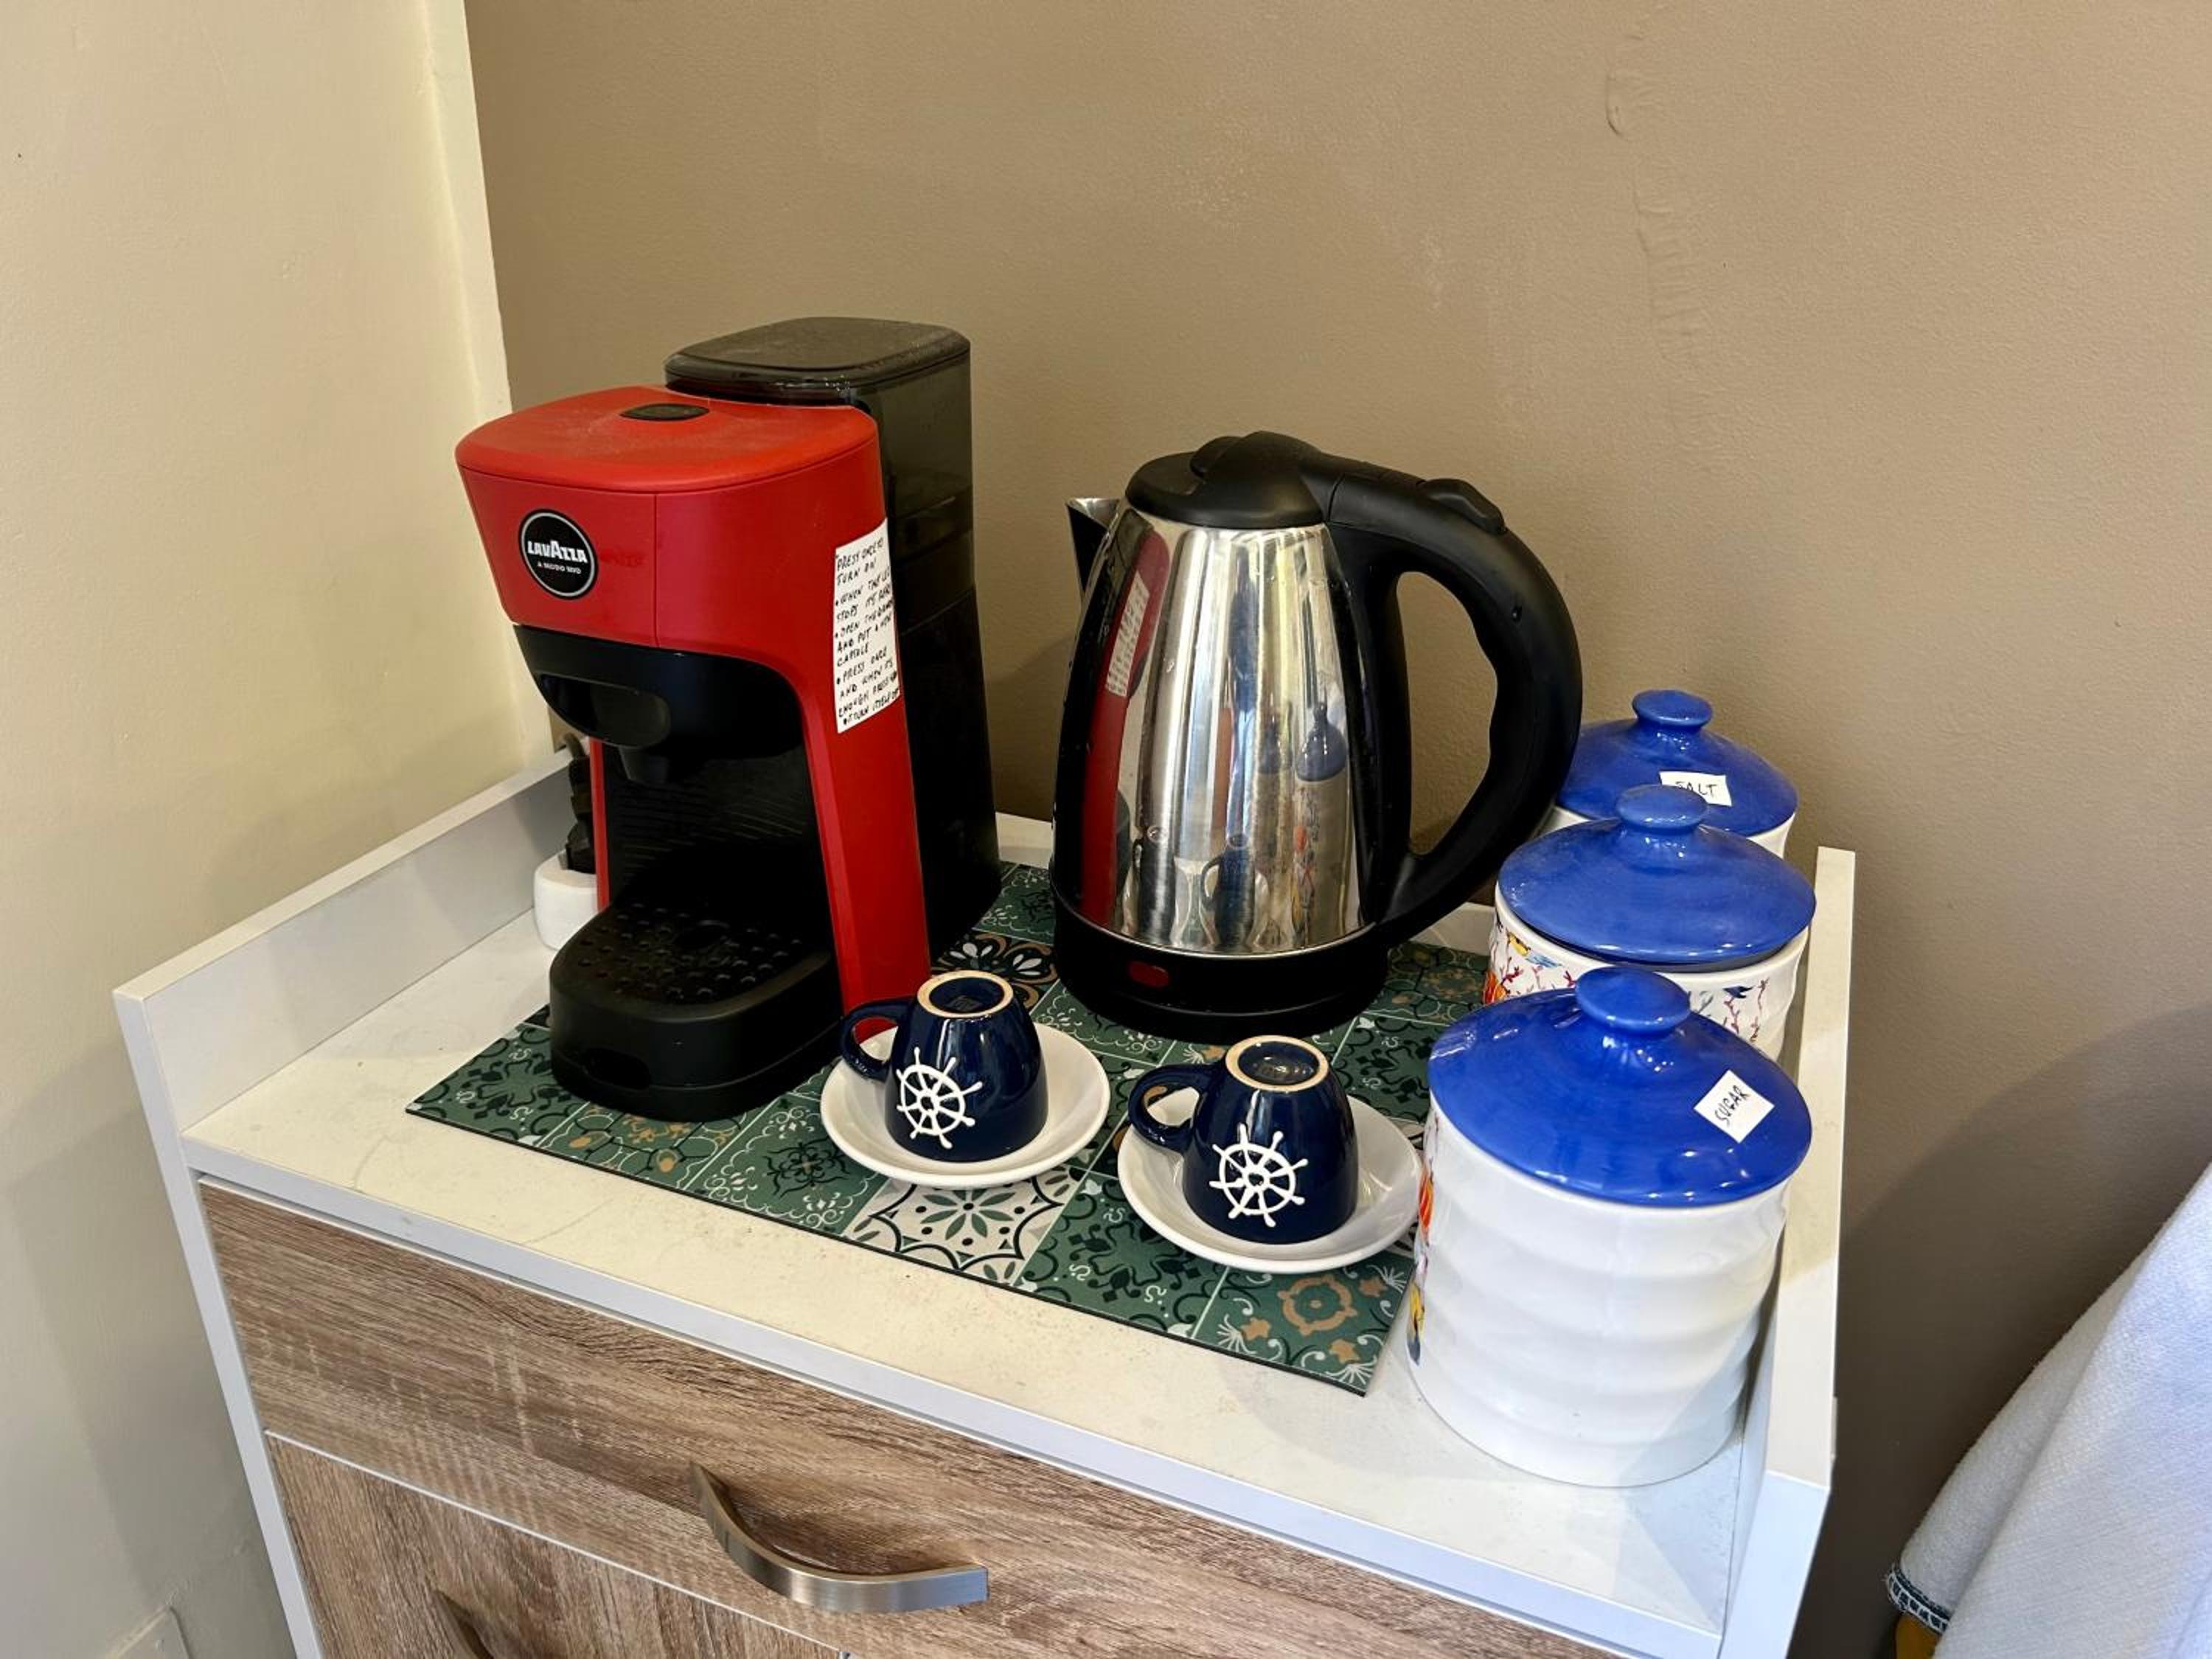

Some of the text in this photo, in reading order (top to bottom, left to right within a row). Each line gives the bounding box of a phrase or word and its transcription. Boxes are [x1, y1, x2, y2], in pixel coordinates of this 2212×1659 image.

[527, 539, 588, 563] LAVAZZA
[838, 552, 859, 571] PRESS
[837, 567, 860, 585] TURN
[837, 604, 858, 621] STOPS
[838, 639, 854, 653] AND
[858, 626, 872, 643] PUT
[841, 622, 860, 638] OPEN
[837, 640, 869, 667] CAPSULE
[843, 661, 864, 683] PRESS
[838, 689, 869, 717] ENOUGH
[840, 684, 858, 701] AND
[1714, 1085, 1751, 1127] SUGAR
